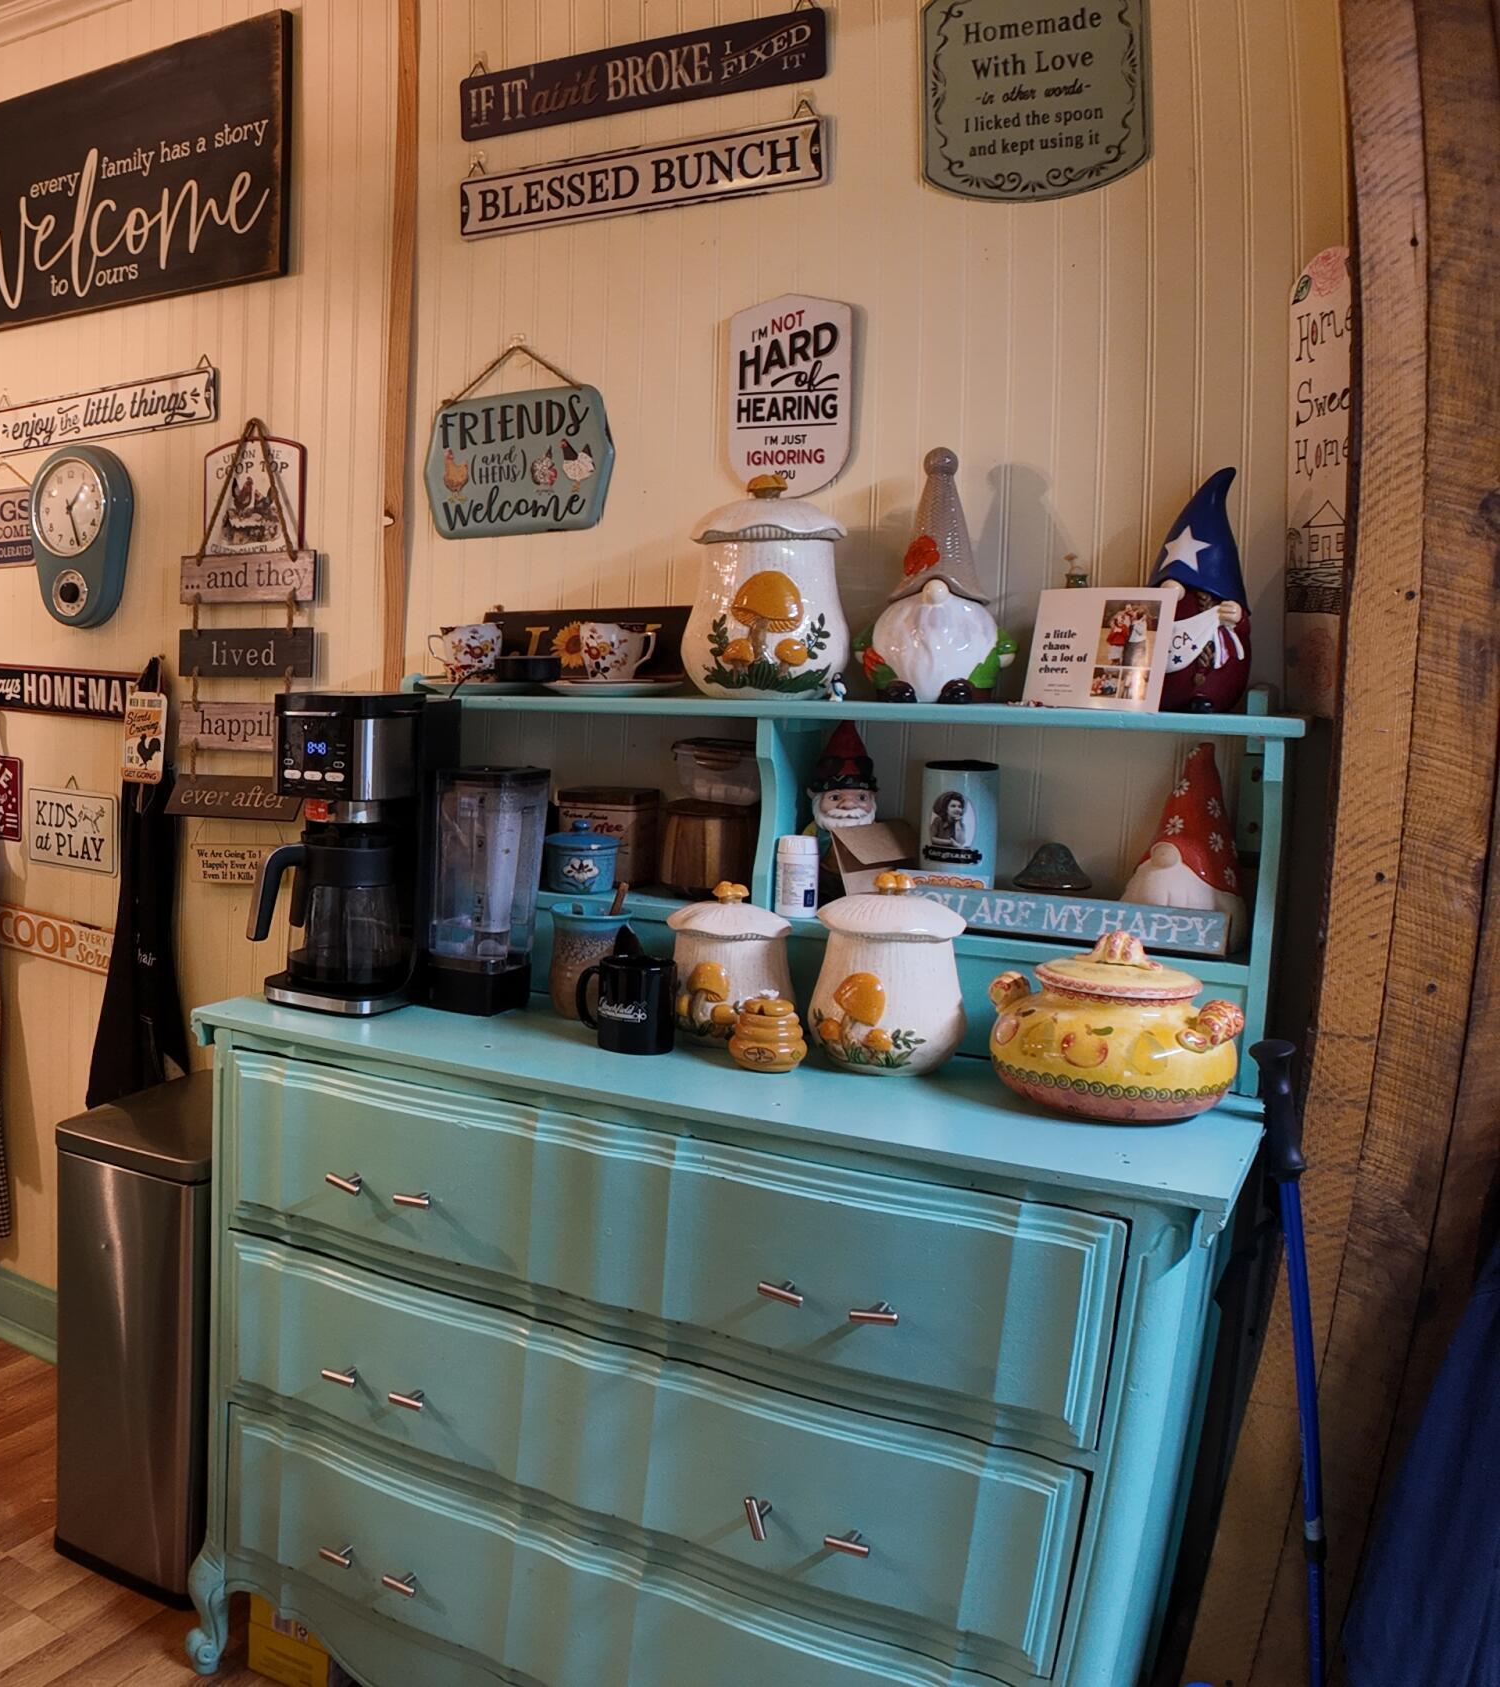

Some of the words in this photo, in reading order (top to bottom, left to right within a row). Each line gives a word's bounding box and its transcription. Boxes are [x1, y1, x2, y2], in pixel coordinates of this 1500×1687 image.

[963, 8, 1102, 46] Homemade
[720, 23, 812, 81] FIXED
[781, 53, 806, 71] IT
[971, 54, 1026, 81] With
[1035, 50, 1094, 74] Love
[468, 84, 495, 129] IF
[501, 80, 529, 122] IT
[531, 63, 600, 118] ain't
[606, 42, 714, 102] BROKE
[724, 40, 732, 55] I
[1002, 84, 1037, 103] other
[964, 118, 970, 133] I
[975, 112, 1021, 132] licked
[1025, 111, 1050, 126] the
[1054, 106, 1104, 129] spoon
[969, 140, 997, 157] and
[1001, 138, 1034, 157] kept
[1040, 132, 1084, 152] using
[1088, 129, 1100, 145] it
[29, 170, 80, 199] every
[100, 150, 155, 180] family
[159, 140, 191, 164] has
[195, 136, 208, 152] a
[213, 118, 269, 149] story
[478, 164, 640, 223] BLESSED
[651, 136, 802, 194] BUNCH
[50, 275, 68, 297] to
[94, 263, 139, 287] ours
[752, 324, 769, 343] I'M
[771, 309, 806, 336] NOT
[738, 321, 839, 391] HARD
[771, 360, 840, 392] of
[736, 394, 838, 424] HEARING
[1295, 378, 1351, 428] Swee
[11, 411, 57, 447] enjoy
[59, 410, 80, 431] the
[83, 397, 126, 428] little
[129, 388, 196, 425] things
[440, 393, 591, 450] FRIENDS
[764, 435, 779, 445] I'M
[781, 434, 808, 445] JUST
[242, 448, 256, 460] ON
[747, 448, 826, 466] IGNORING
[216, 461, 255, 480] COOP
[260, 461, 290, 474] TOP
[442, 489, 586, 531] Welcome
[206, 562, 252, 590] and
[256, 560, 309, 594] they
[1042, 641, 1071, 650] chaos
[1053, 629, 1077, 639] little
[211, 640, 277, 668] lived
[1041, 653, 1049, 662] &
[1060, 652, 1074, 662] lot
[1076, 652, 1088, 662] of
[1038, 664, 1068, 673] cheer.
[199, 709, 272, 742] happil
[124, 769, 136, 778] GET
[136, 770, 157, 780] GOING
[180, 788, 229, 807] ever
[232, 785, 289, 809] after
[35, 800, 78, 828] KIDS
[35, 834, 52, 851] at
[56, 833, 106, 863] PLAY
[197, 850, 208, 858] We
[210, 850, 223, 858] Are
[224, 849, 245, 860] Going
[248, 850, 257, 859] To
[202, 860, 228, 871] Happily
[230, 861, 247, 870] Ever
[222, 872, 229, 880] If
[238, 872, 254, 881] Kills
[969, 897, 1036, 931] ARE
[1041, 902, 1097, 933] MY
[1099, 908, 1222, 948] HAPPY.
[79, 930, 108, 946] EVERY
